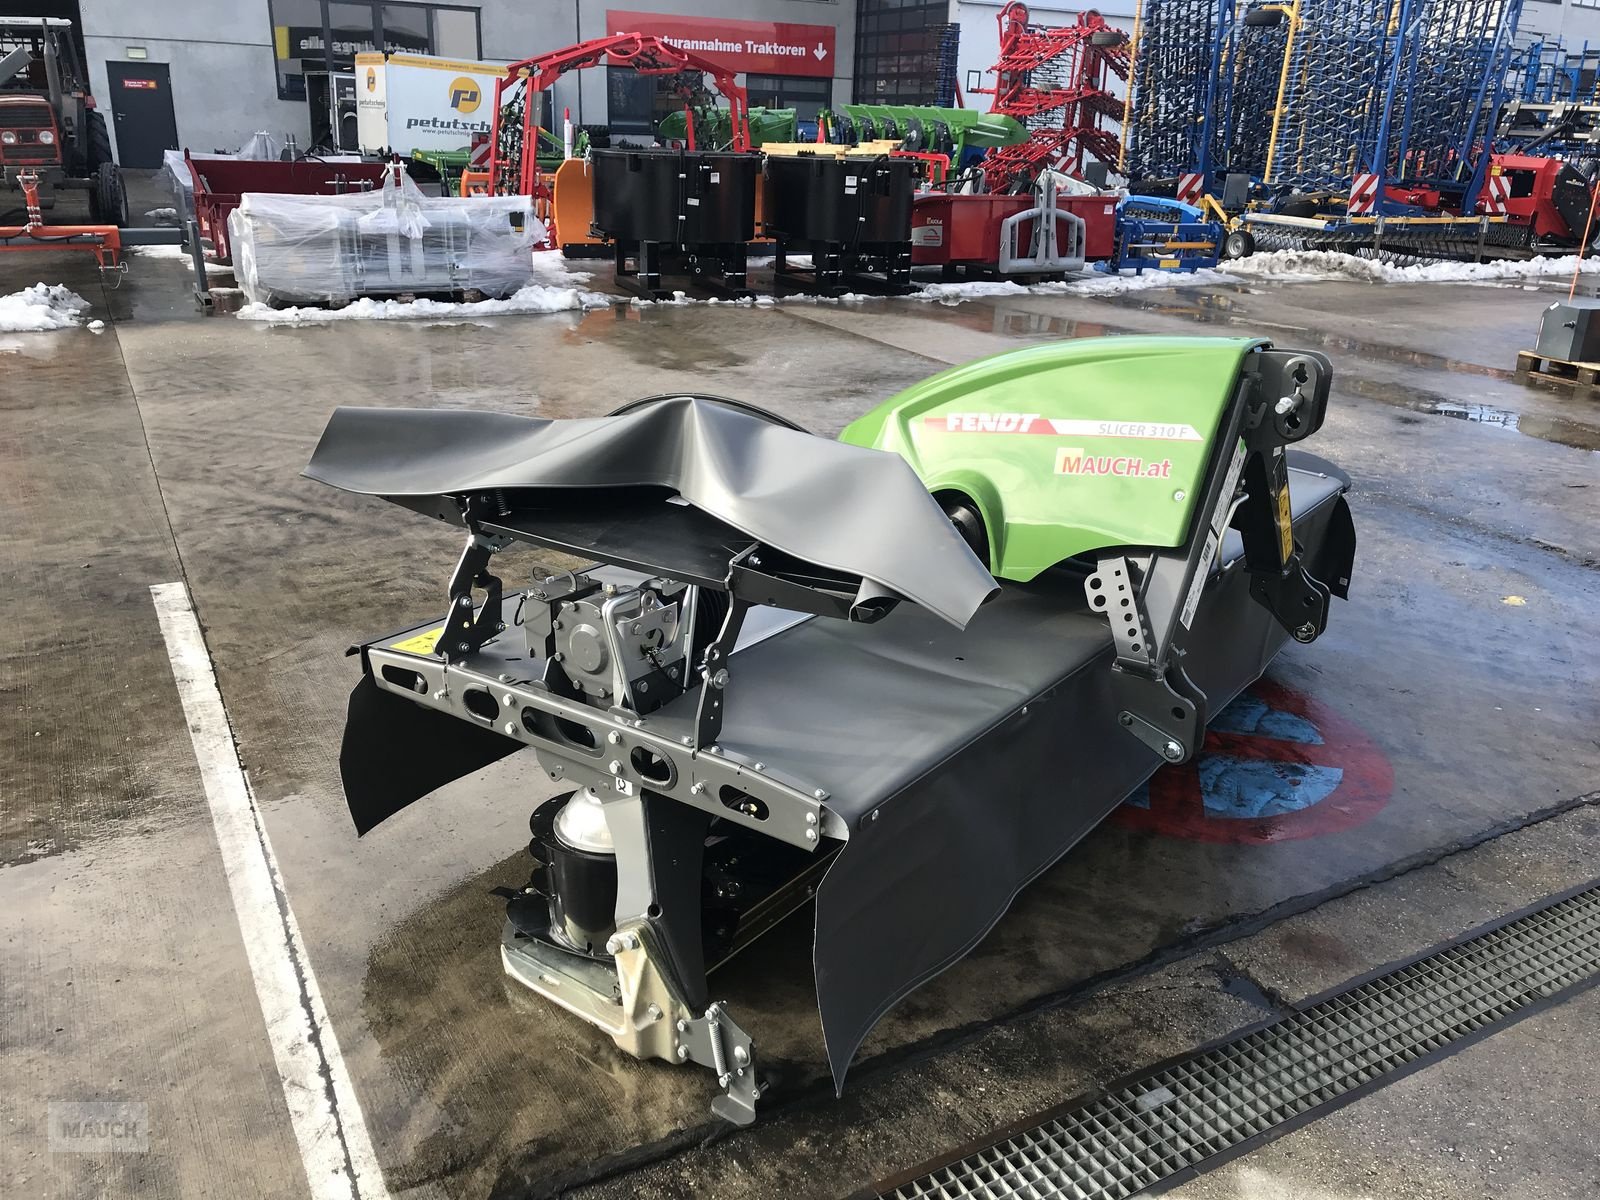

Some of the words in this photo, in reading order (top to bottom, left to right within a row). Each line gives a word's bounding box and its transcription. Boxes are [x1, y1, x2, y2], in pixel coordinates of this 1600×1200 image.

[745, 40, 806, 56] Traktoren
[406, 117, 491, 131] petutsch
[946, 413, 1040, 432] FENDT
[1098, 423, 1146, 436] SLICER
[1149, 426, 1176, 438] 310
[1179, 427, 1189, 438] F
[1062, 456, 1171, 478] MAUCH.at
